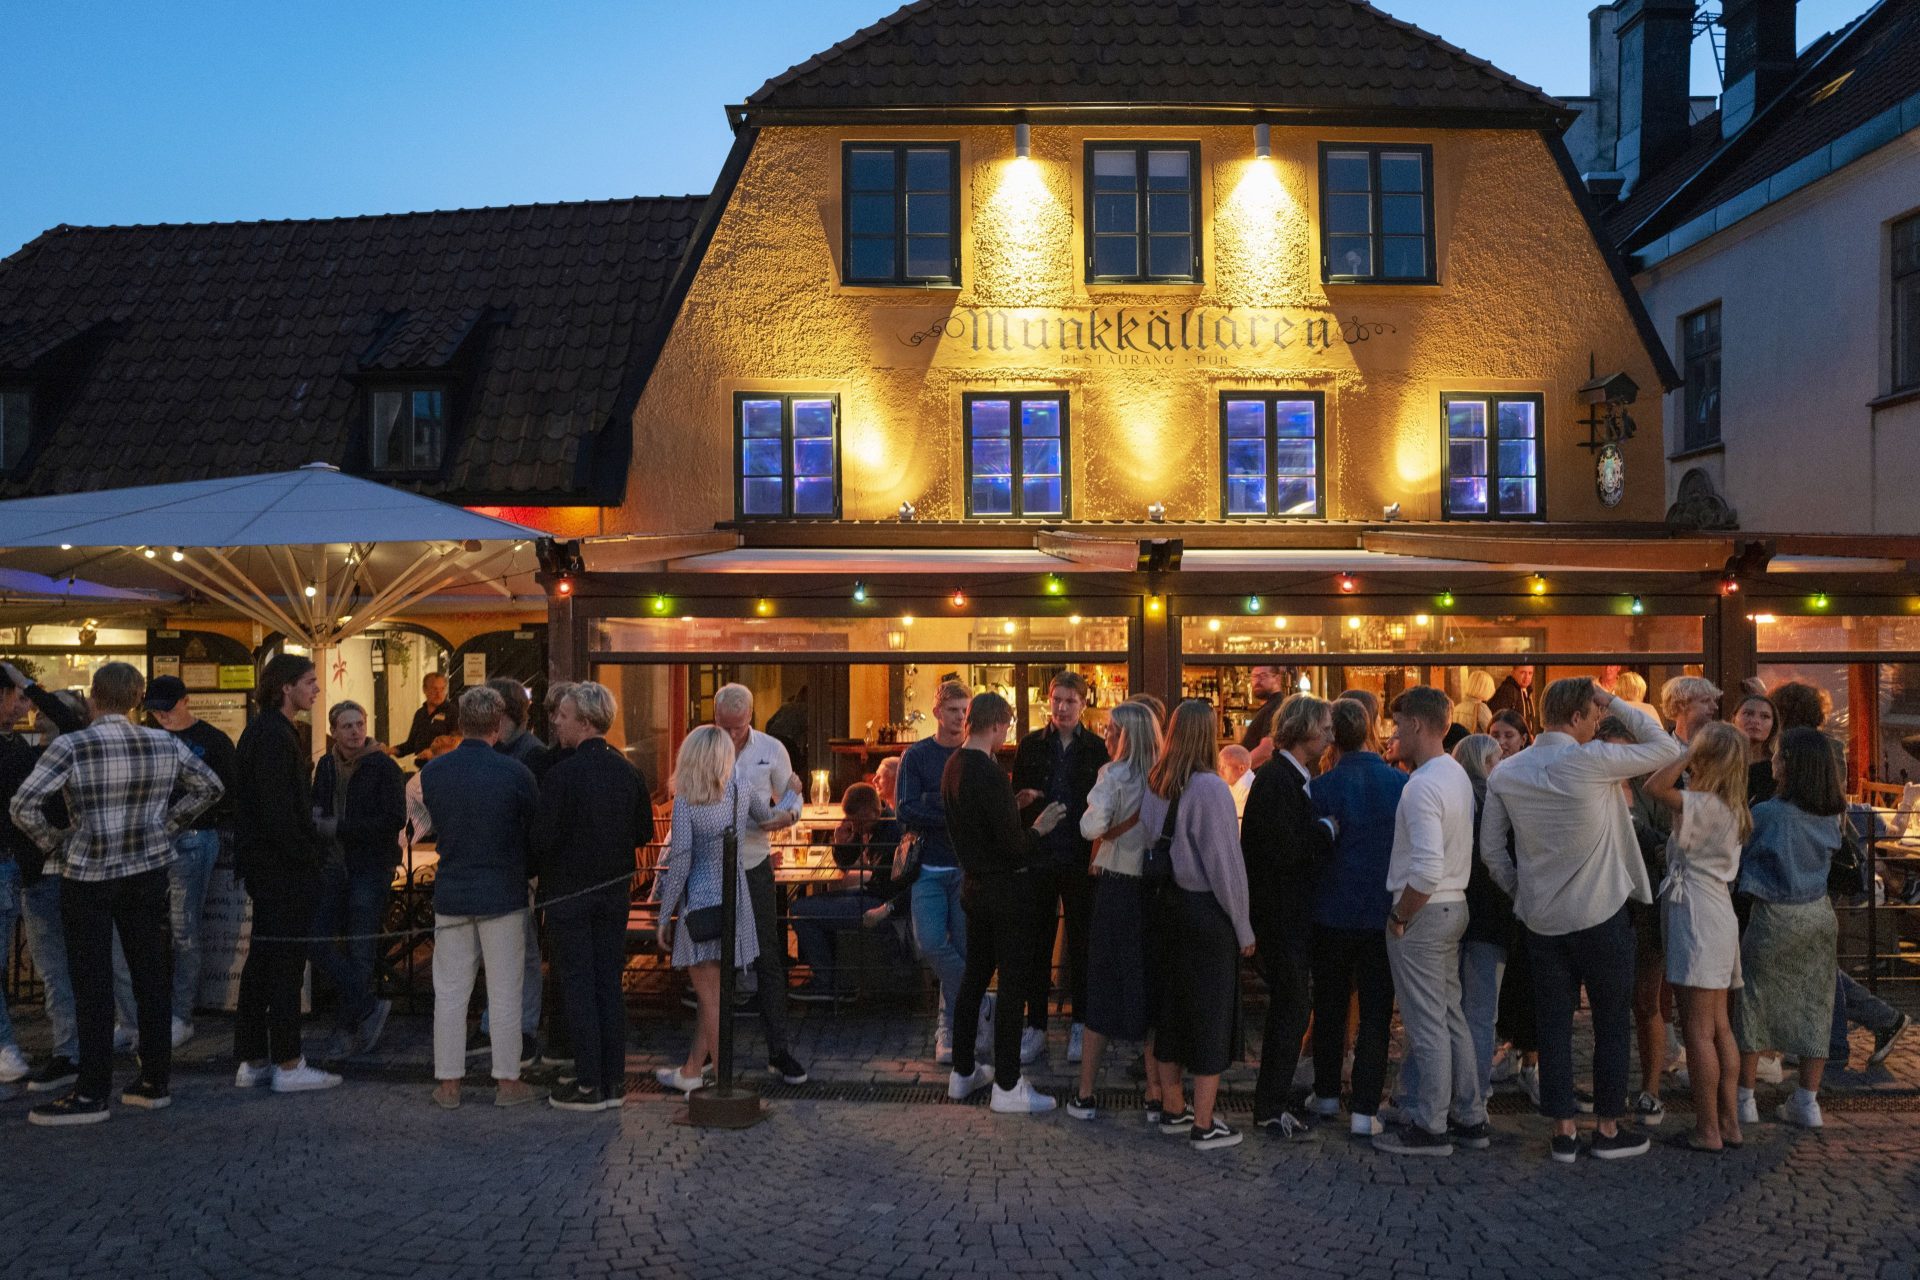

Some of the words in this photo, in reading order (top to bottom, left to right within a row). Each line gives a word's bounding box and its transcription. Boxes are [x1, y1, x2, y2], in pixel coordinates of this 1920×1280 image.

[966, 307, 1333, 354] Munkkällaren
[1061, 354, 1174, 366] RESTAURANG
[1196, 355, 1229, 366] PUB
